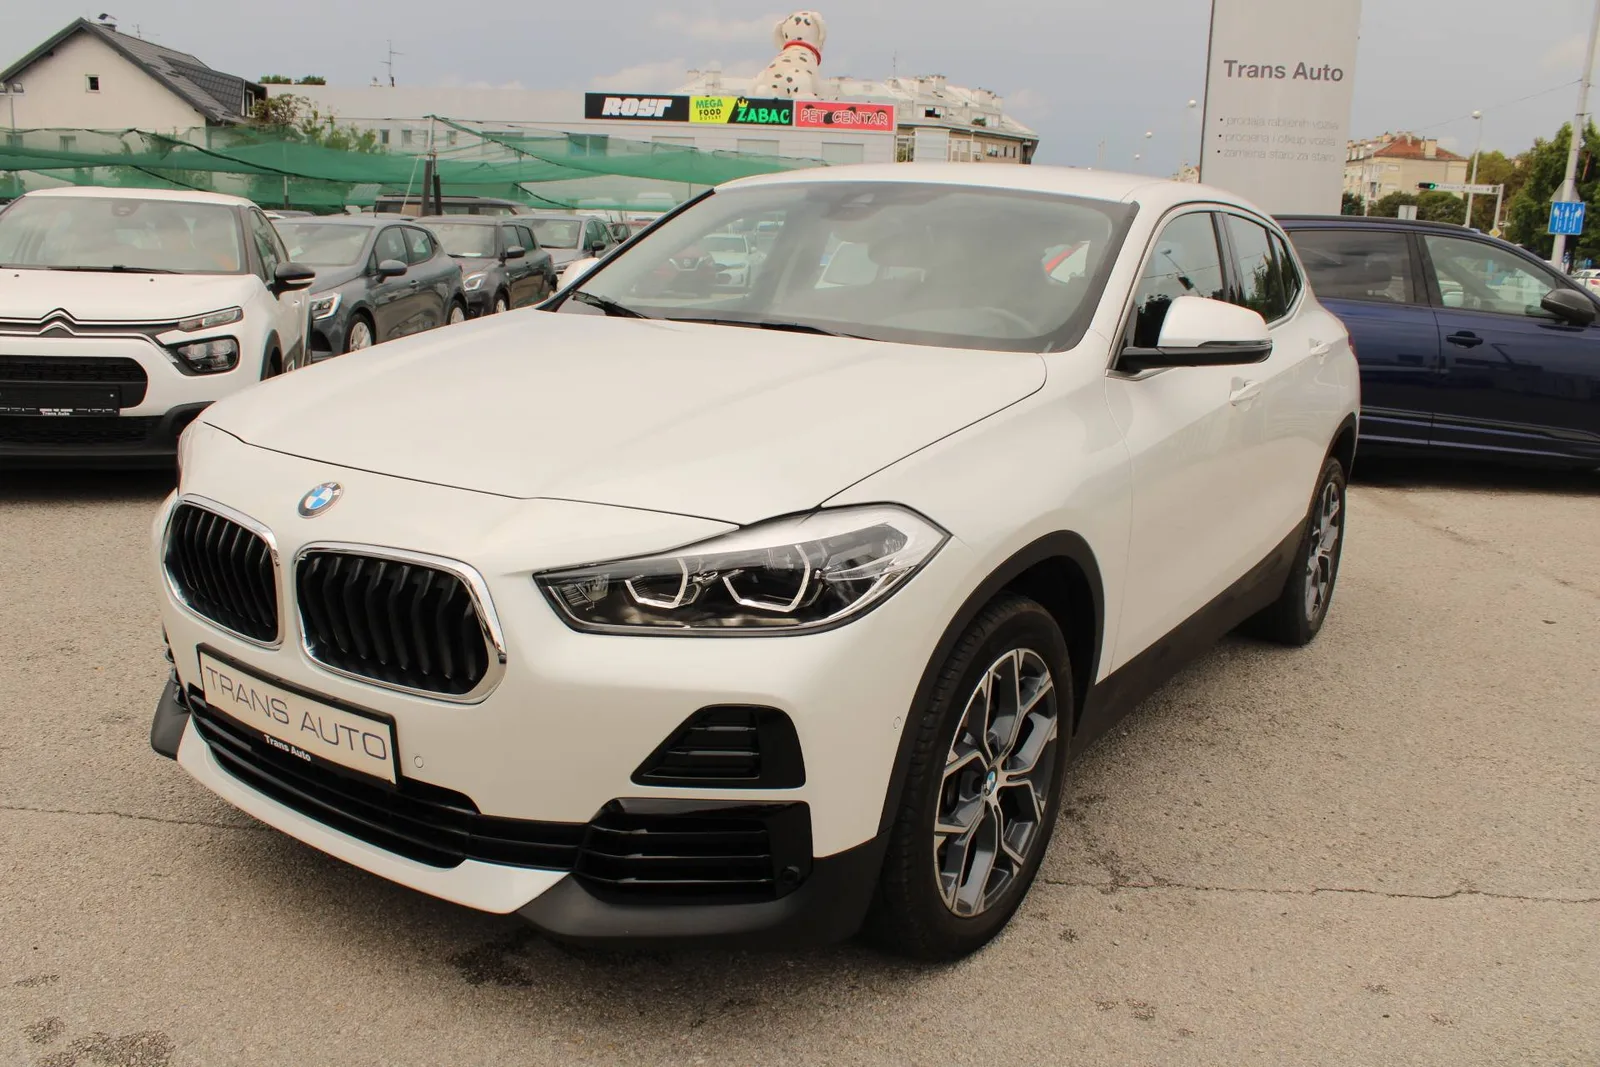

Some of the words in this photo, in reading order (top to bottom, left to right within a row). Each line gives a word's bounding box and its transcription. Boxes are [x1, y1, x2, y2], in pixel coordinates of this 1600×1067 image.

[1223, 59, 1286, 79] Trans
[1292, 62, 1344, 82] Auto
[602, 97, 673, 117] ROST
[696, 99, 723, 109] MEGA
[699, 108, 721, 116] FOOD
[800, 108, 827, 123] PET
[832, 110, 888, 126] CENTAR
[205, 666, 290, 725] TRANS
[300, 711, 387, 760] AUTO
[264, 734, 290, 752] Trans
[291, 745, 311, 762] Auto
